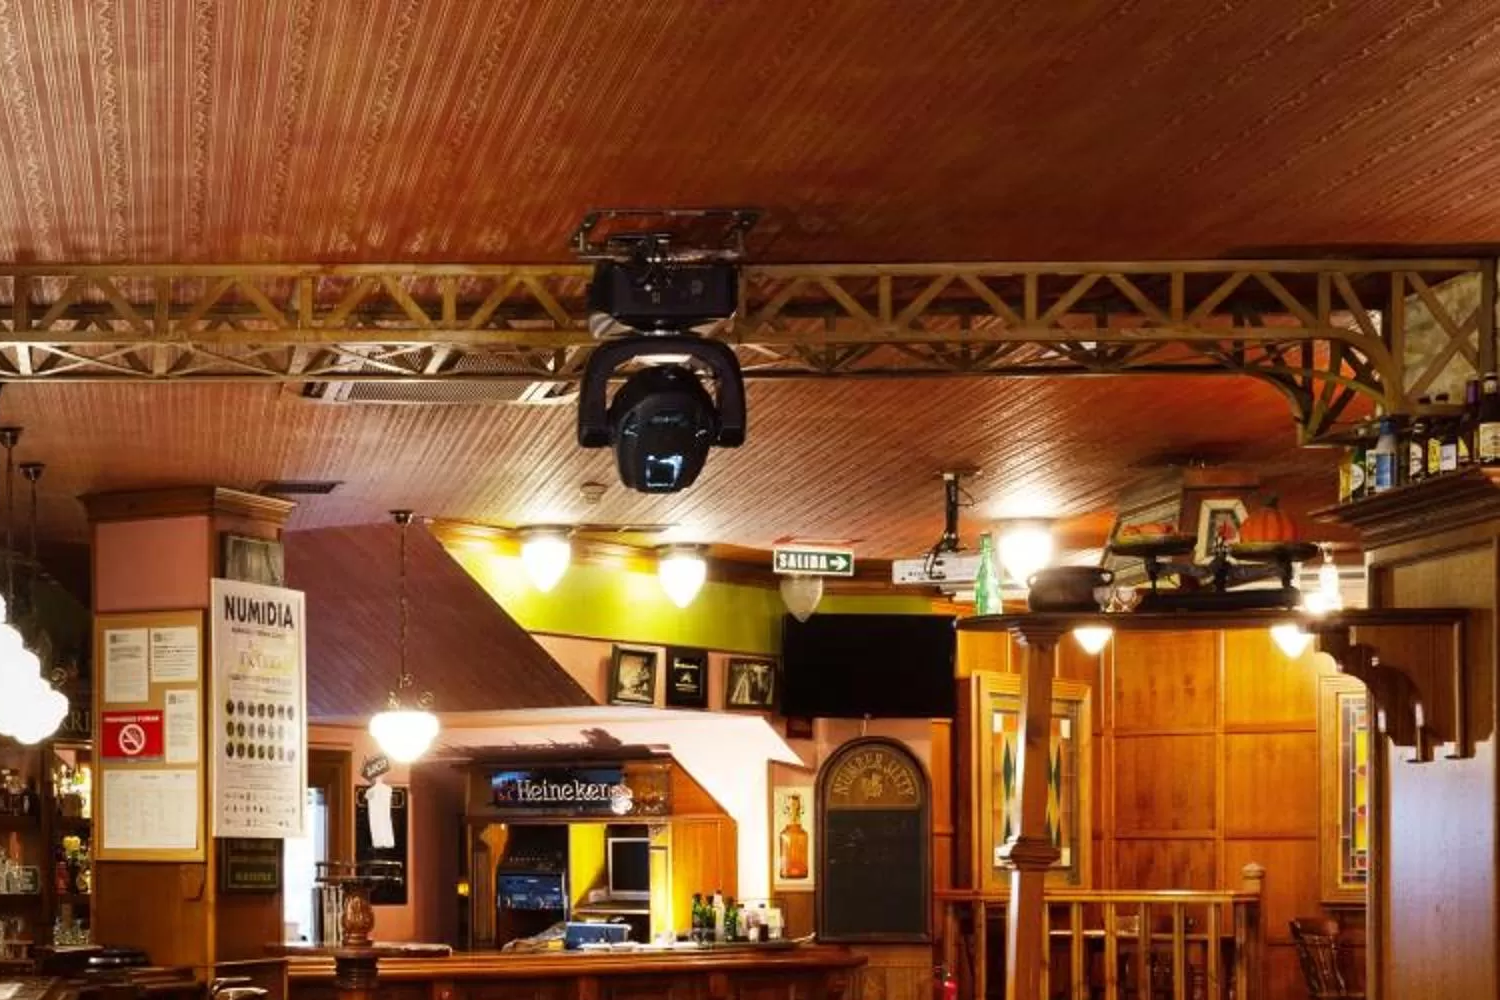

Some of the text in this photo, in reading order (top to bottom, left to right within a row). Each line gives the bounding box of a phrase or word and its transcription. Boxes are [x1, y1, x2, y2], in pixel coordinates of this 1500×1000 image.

[779, 553, 828, 569] SALIDA
[224, 595, 294, 629] NUMIDIA
[517, 778, 614, 801] Heineken
